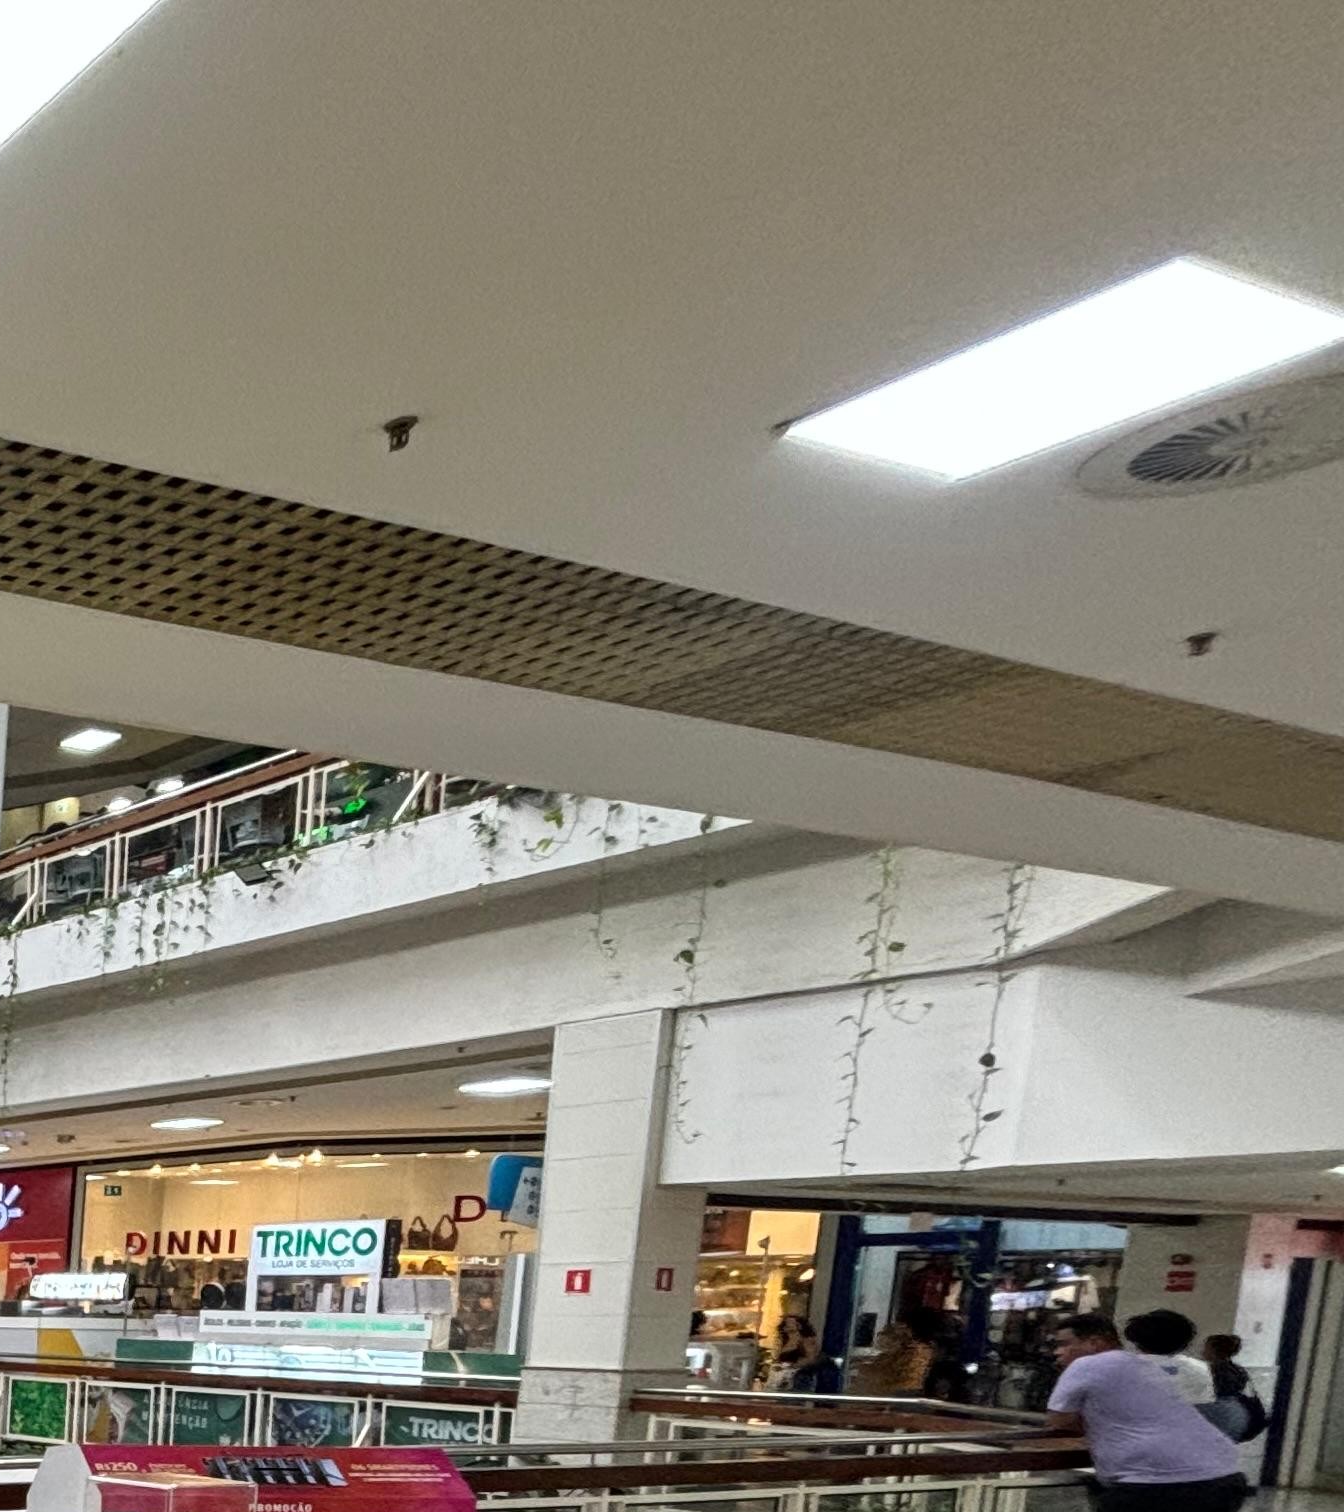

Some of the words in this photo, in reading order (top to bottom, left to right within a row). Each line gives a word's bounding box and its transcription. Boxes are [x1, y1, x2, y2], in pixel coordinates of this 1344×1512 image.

[126, 1228, 237, 1256] DINNI
[256, 1226, 378, 1258] TRINCO
[296, 1260, 308, 1269] DE
[409, 1416, 496, 1444] TRINCO
[248, 1502, 313, 1512] PROMOÇÃO
